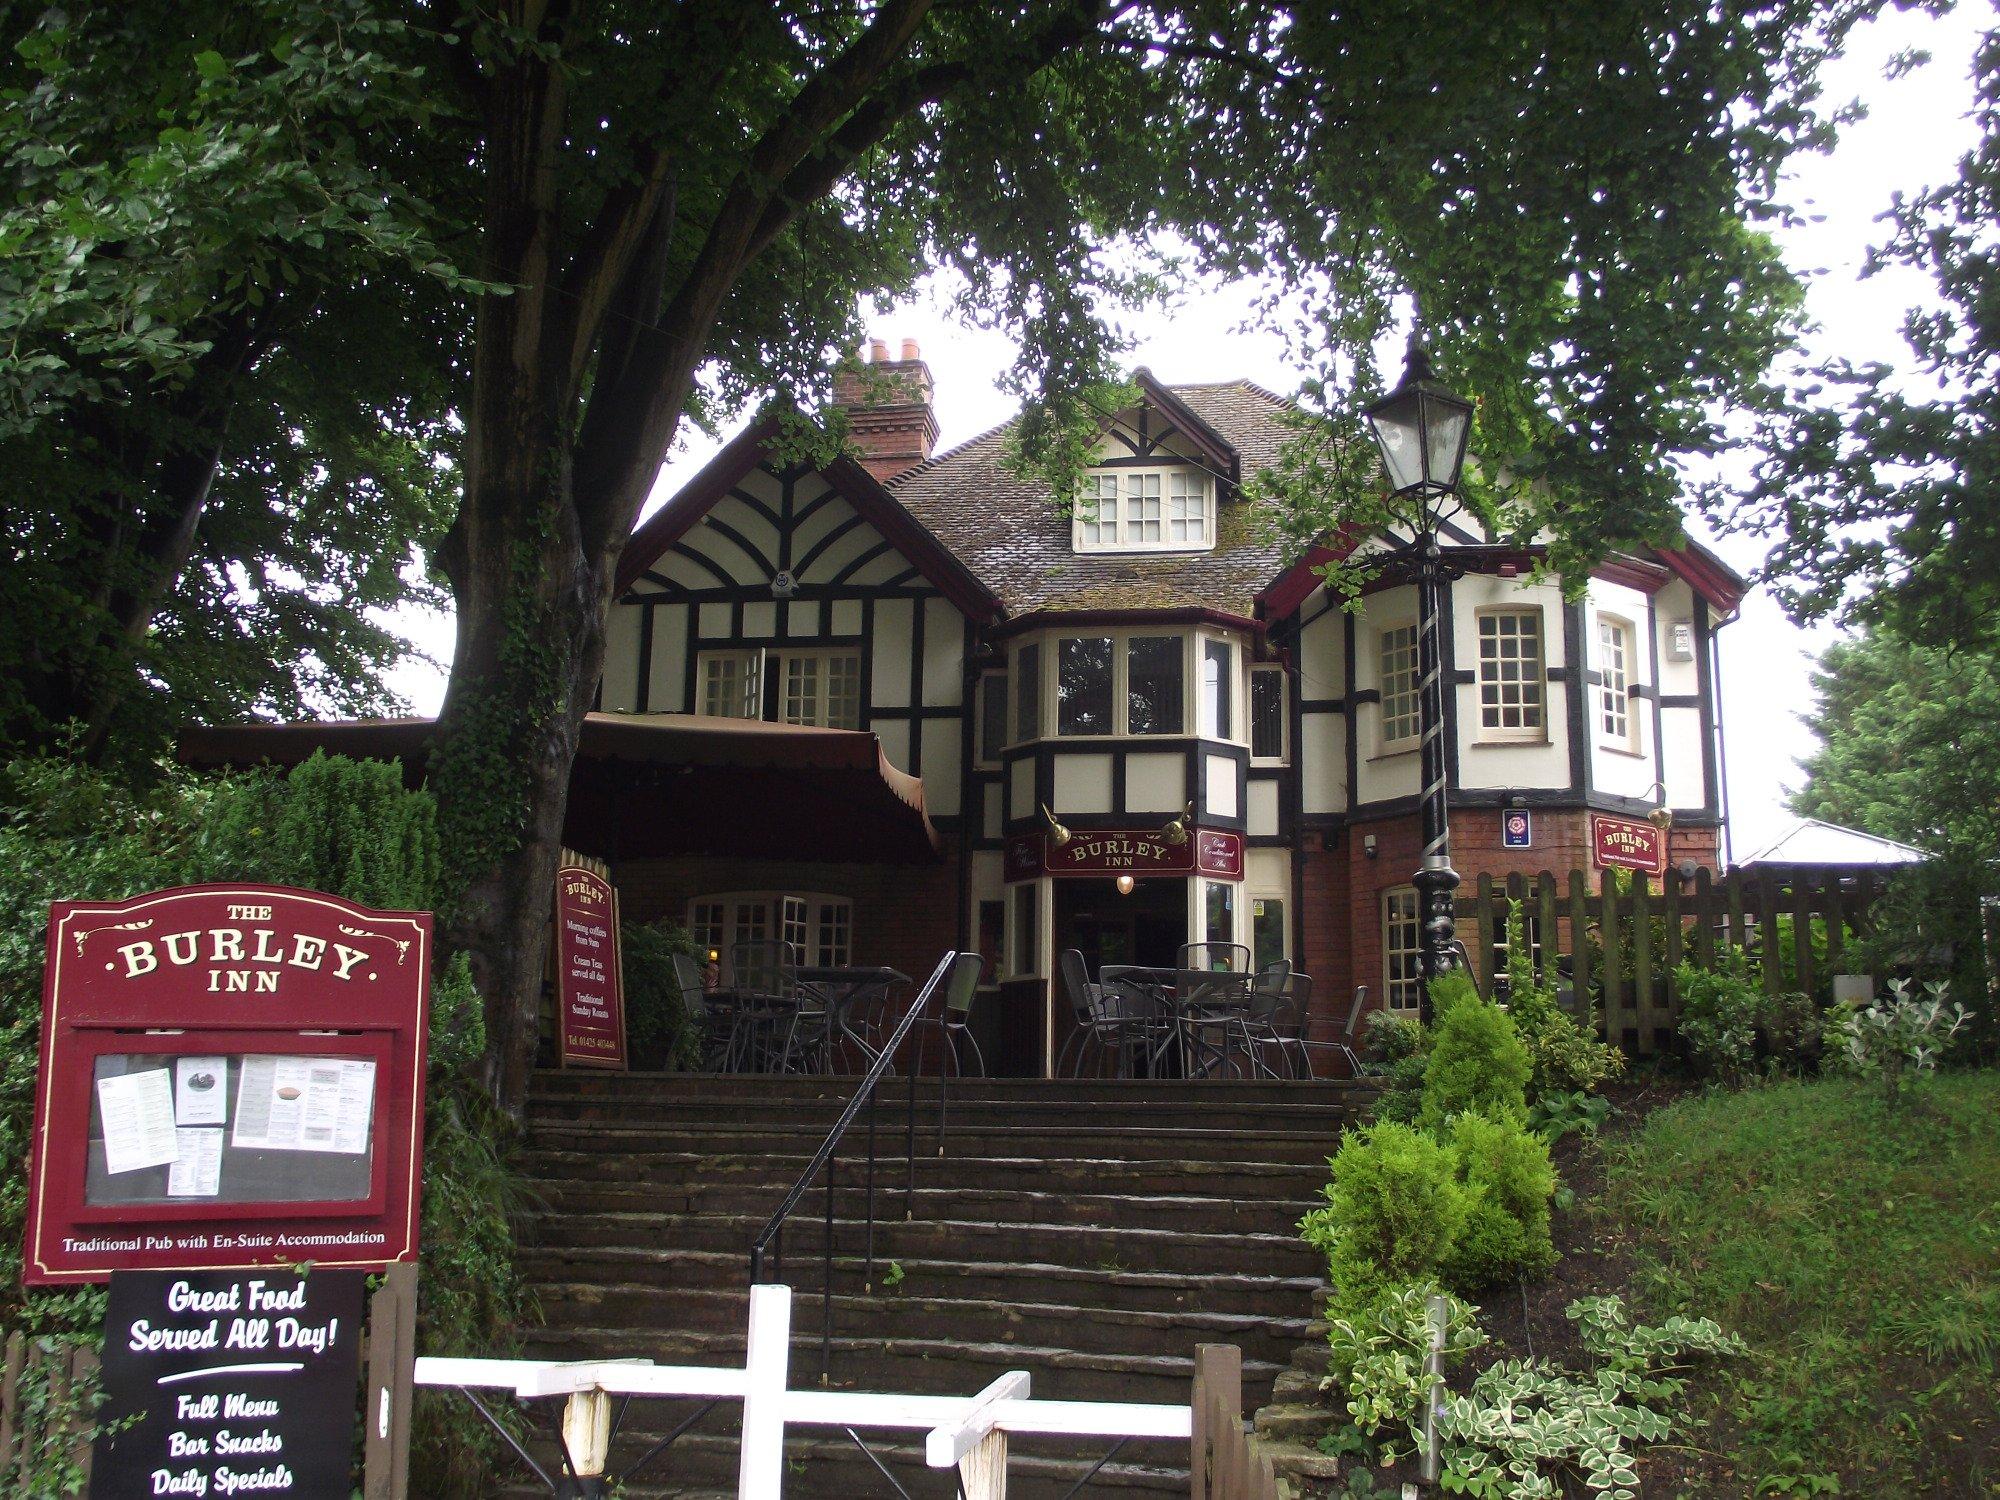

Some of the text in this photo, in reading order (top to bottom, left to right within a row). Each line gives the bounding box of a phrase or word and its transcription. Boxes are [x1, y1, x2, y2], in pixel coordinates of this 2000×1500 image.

[1071, 840, 1168, 862] BURLEY
[1605, 832, 1650, 852] BURLEY
[1621, 844, 1635, 854] INN
[1105, 856, 1133, 866] INN
[567, 882, 604, 904] BURLEY
[227, 904, 272, 920] THE
[567, 919, 607, 938] Morning coffees
[575, 933, 588, 946] from
[116, 928, 369, 981] BURLEY
[573, 954, 603, 970] Cream Teas
[207, 970, 281, 993] INN
[571, 968, 589, 979] served
[596, 971, 606, 984] day
[576, 991, 604, 1006] Traditional
[572, 1003, 591, 1018] Sunday
[579, 1036, 596, 1048] 01425
[62, 1230, 386, 1253] Traditional Pub with En-Suite Accommodation
[168, 1280, 306, 1313] Great Food
[129, 1318, 338, 1354] Served All Day!
[177, 1392, 279, 1420] Full Menu
[168, 1428, 282, 1458] Bar Snacks
[151, 1463, 293, 1498] Daily Specials
